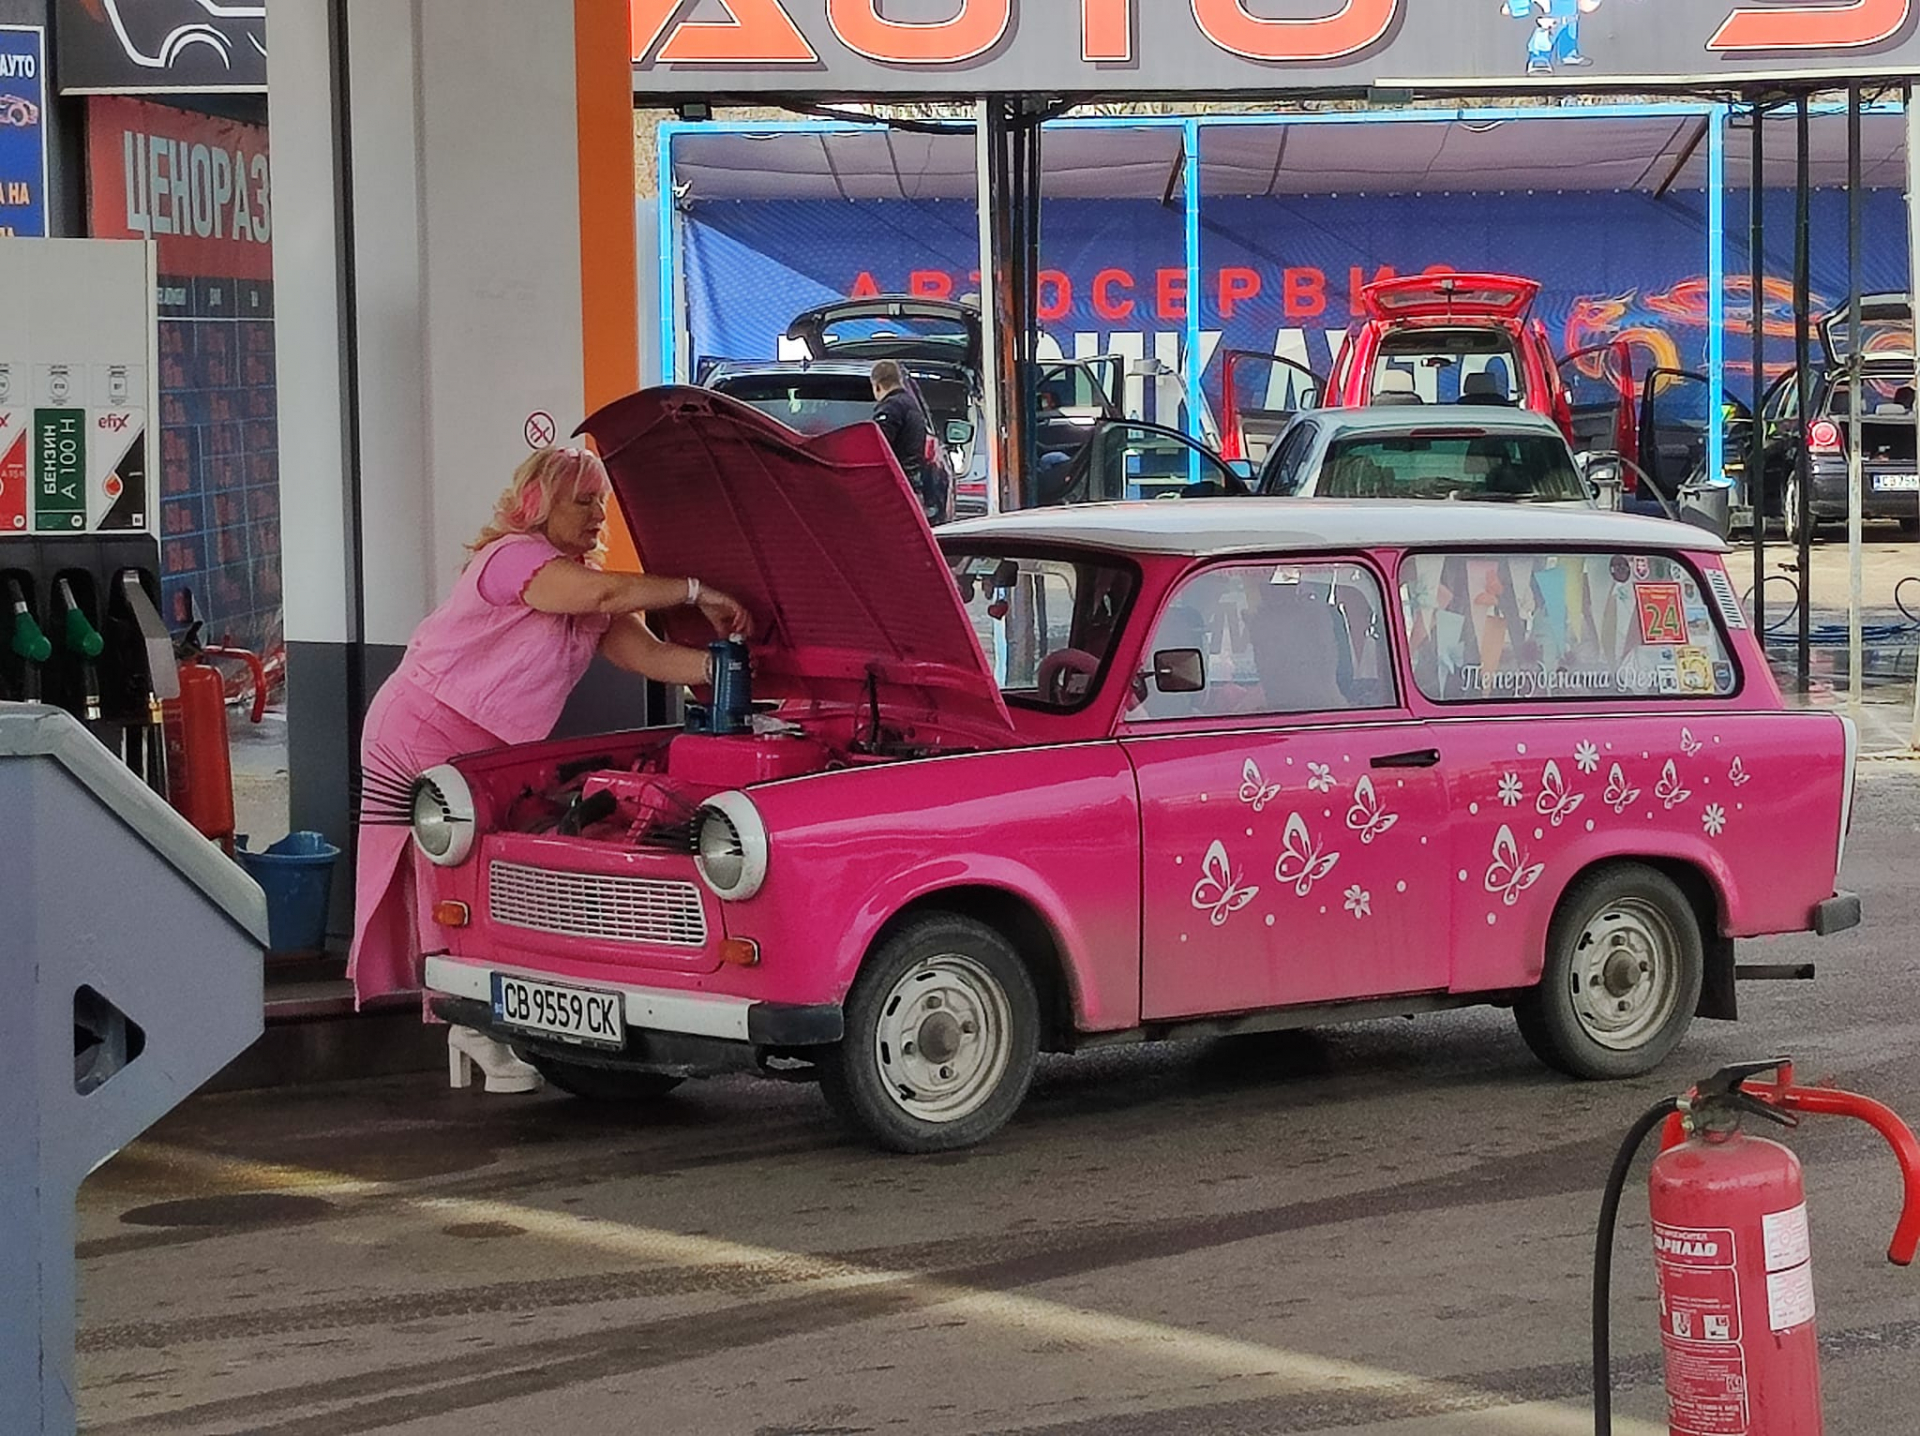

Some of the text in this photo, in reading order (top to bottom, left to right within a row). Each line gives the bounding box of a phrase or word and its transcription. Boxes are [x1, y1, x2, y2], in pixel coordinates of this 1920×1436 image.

[98, 413, 130, 432] efix
[43, 425, 57, 495] БЕНЗИН
[60, 439, 77, 474] 100
[1645, 603, 1680, 635] 24
[532, 989, 583, 1030] 9559
